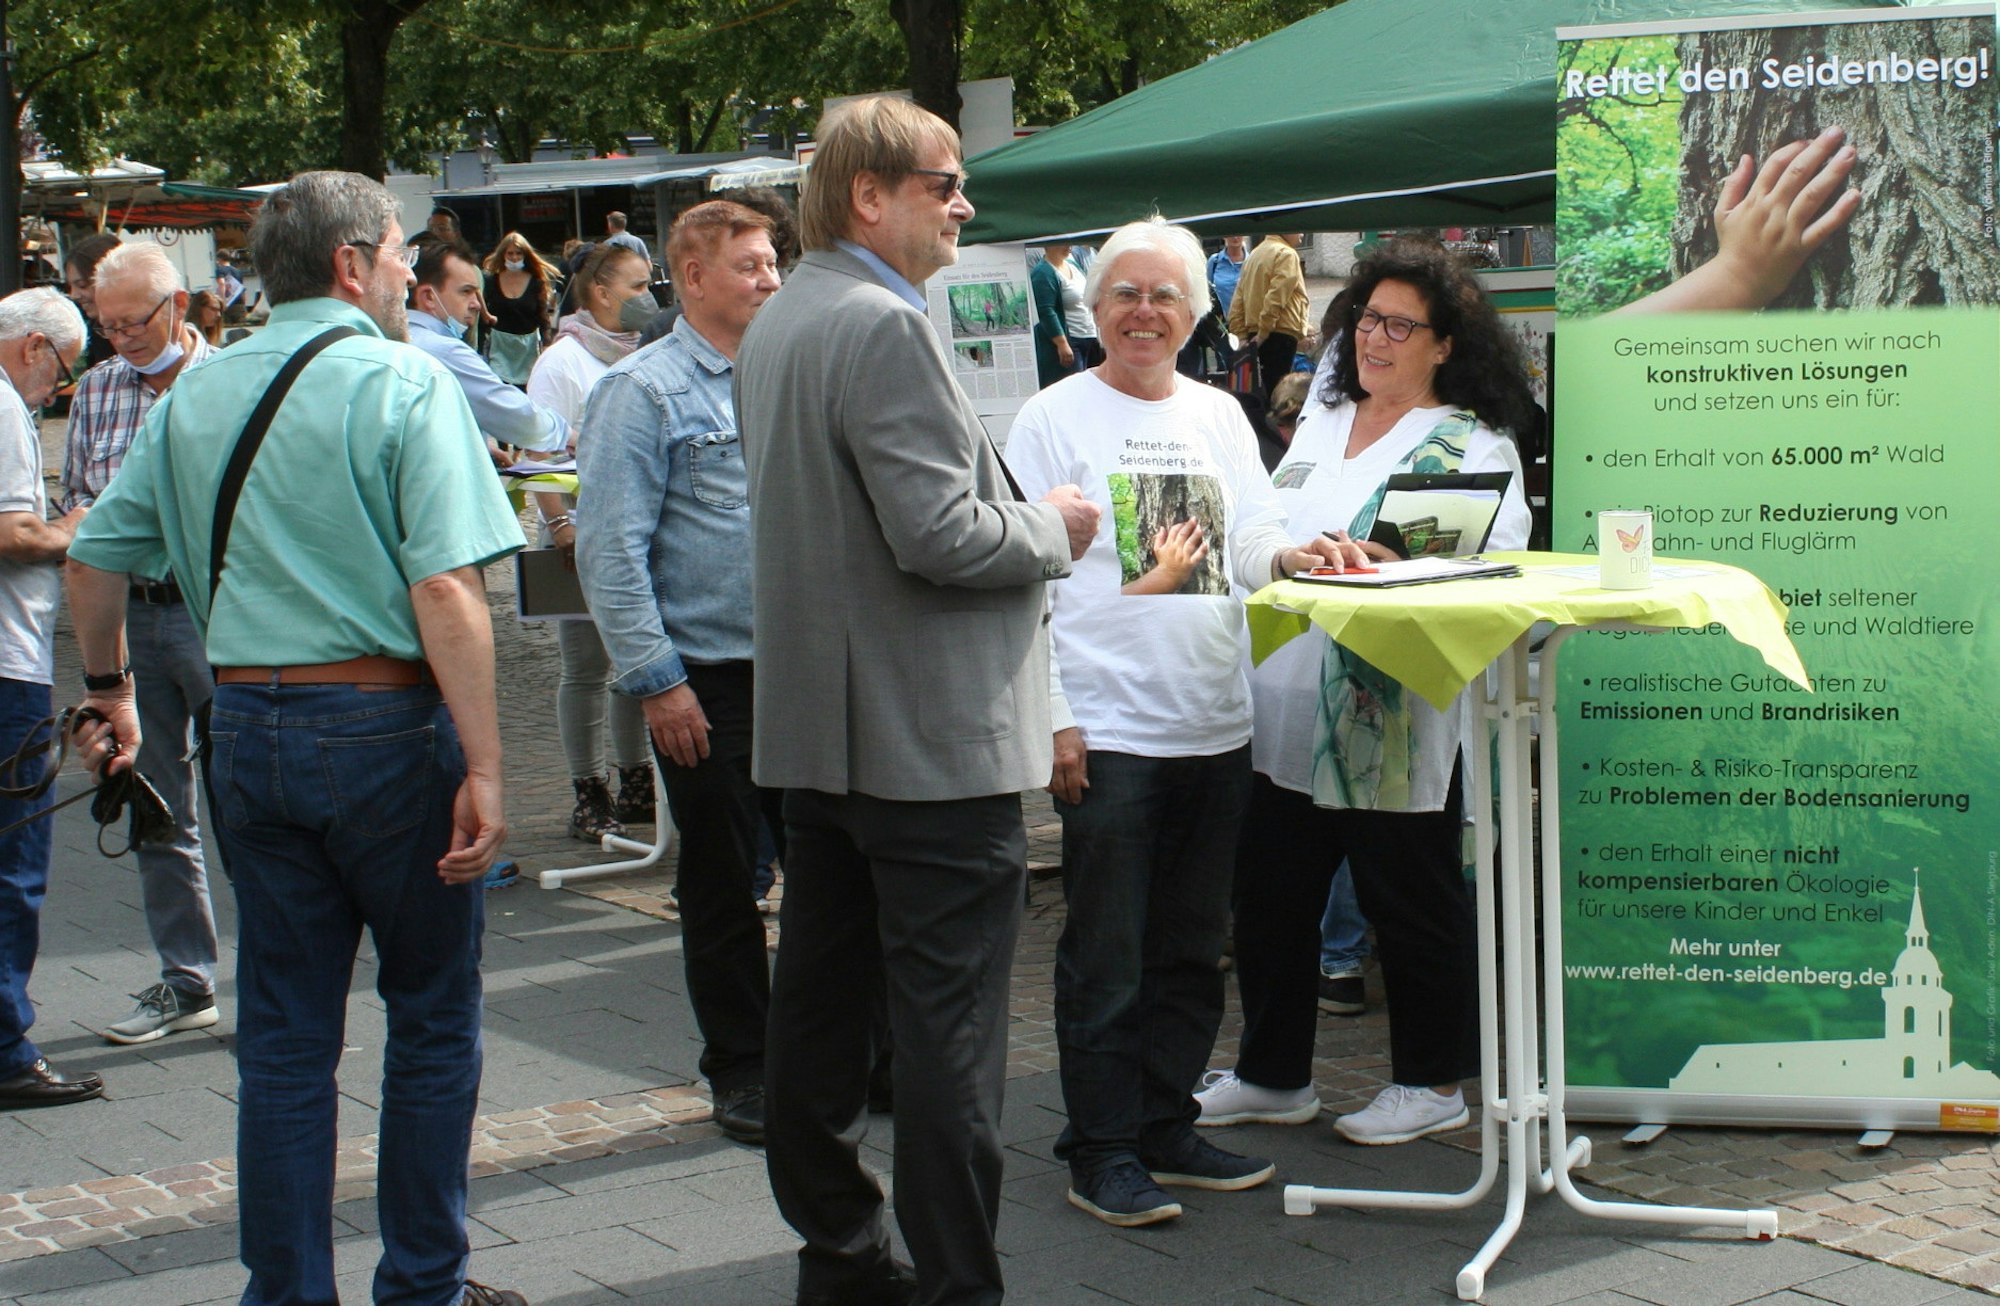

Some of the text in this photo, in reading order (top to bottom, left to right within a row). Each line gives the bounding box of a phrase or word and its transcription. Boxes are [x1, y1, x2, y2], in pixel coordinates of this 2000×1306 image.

[1566, 48, 1989, 98] Rettet den Seidenberg!
[1614, 331, 1941, 357] Gemeinsam suchen wir nach
[1647, 361, 1908, 384] konstruktiven Lösungen
[1654, 388, 1900, 411] und setzen uns ein für:
[1125, 439, 1192, 451] Rettet-den-
[1603, 444, 1944, 467] den Erhalt von 65.000 m² Wald
[1119, 454, 1204, 469] Seidenberg.de
[1721, 506, 1750, 522] zur
[1759, 502, 1898, 527] Reduzierung
[1905, 504, 1947, 520] von
[1711, 531, 1753, 551] und
[1761, 530, 1856, 555] Fluglärm
[1828, 589, 1917, 607] seltener
[1813, 617, 1857, 635] und
[1864, 617, 1974, 635] Waldtiere
[1600, 673, 1722, 693] realistische
[1863, 678, 1886, 693] zu
[1580, 702, 1899, 721] Emissionen und Brandrisiken
[1600, 758, 1919, 783] Kosten- & Risiko-Transparenz
[1579, 786, 1970, 812] zu Problemen der Bodensanierung
[1600, 843, 1840, 865] den Erhalt einer nicht
[1578, 870, 1890, 899] kompensierbaren Ökologie
[1578, 898, 1884, 923] für unsere Kinder und Enkel
[1669, 938, 1781, 957] Mehr unter
[1565, 962, 1887, 988] www.rettet-den-seidenberg.de
